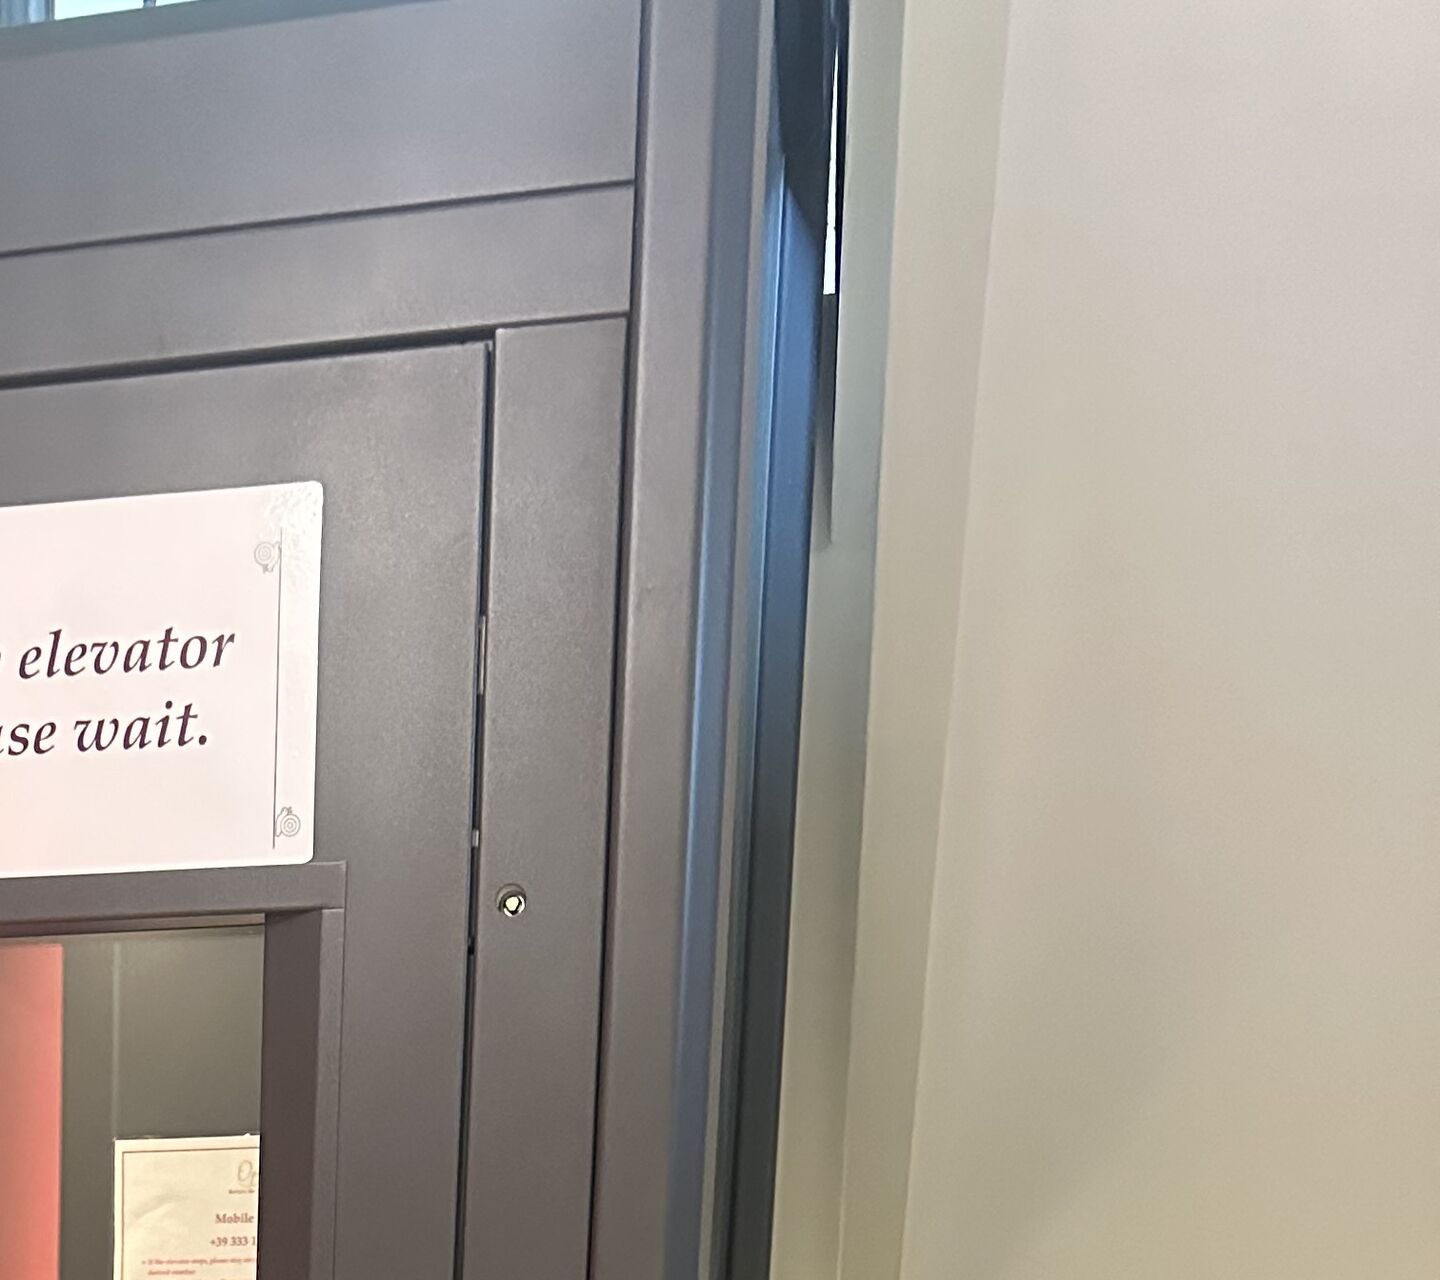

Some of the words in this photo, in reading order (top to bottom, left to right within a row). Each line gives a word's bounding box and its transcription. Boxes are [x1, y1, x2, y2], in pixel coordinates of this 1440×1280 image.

[18, 626, 236, 681] elevator
[72, 700, 208, 754] wait.
[215, 1213, 255, 1224] Mobile
